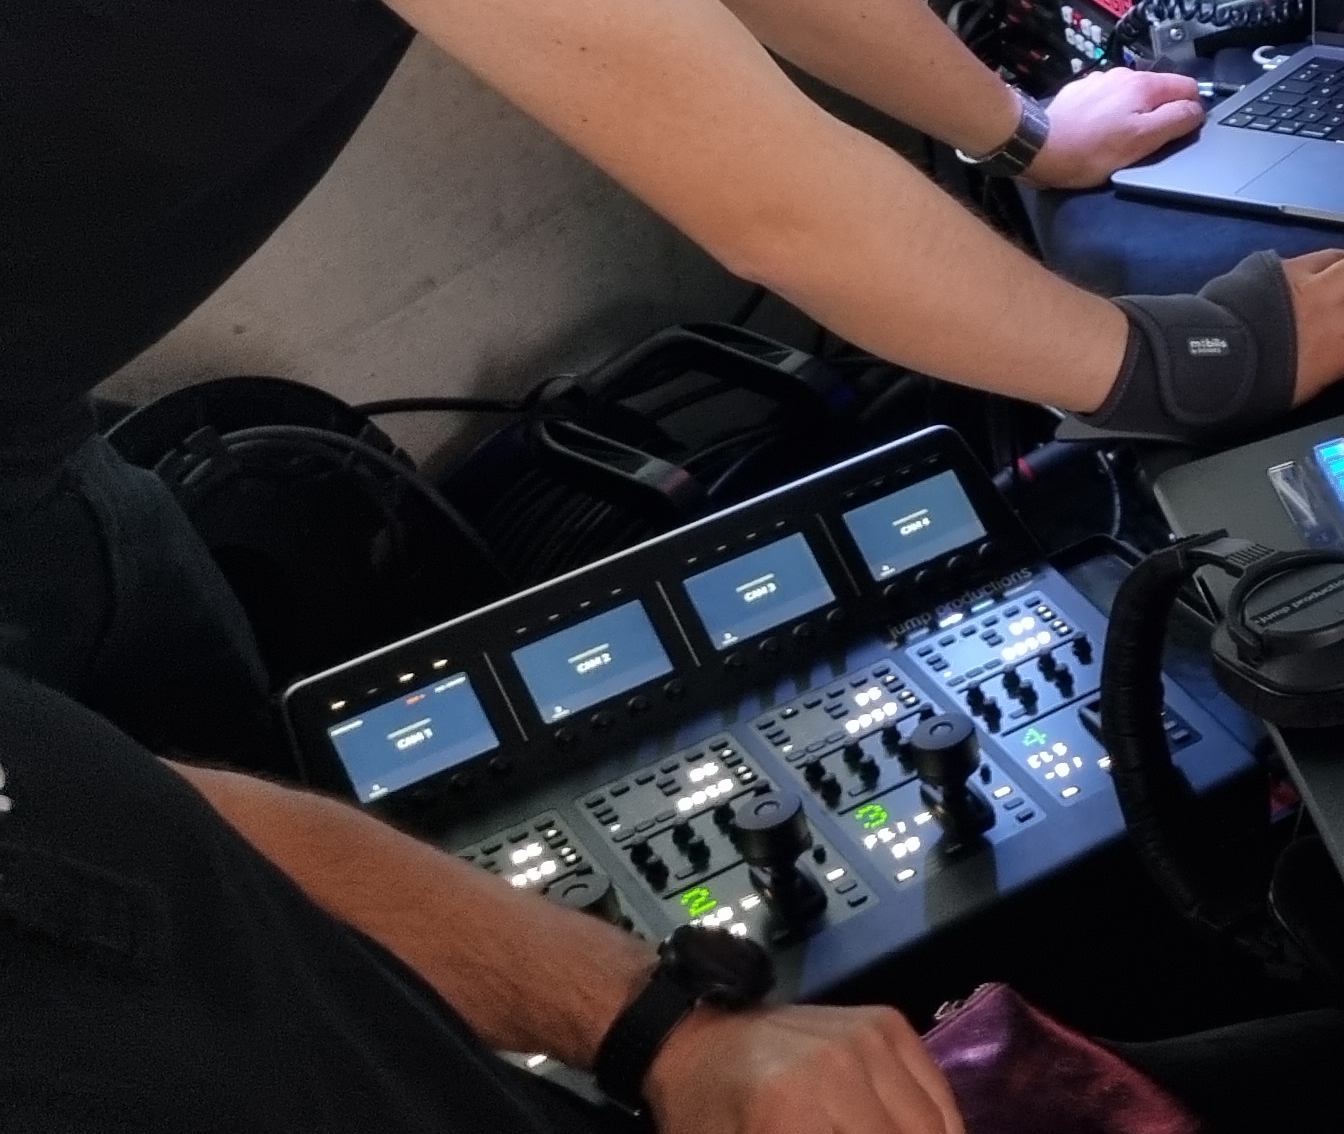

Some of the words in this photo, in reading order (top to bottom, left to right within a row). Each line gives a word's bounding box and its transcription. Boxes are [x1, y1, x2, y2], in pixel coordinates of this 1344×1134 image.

[744, 585, 768, 602] CAM
[889, 610, 931, 638] jump
[935, 567, 1033, 615] productions
[1260, 604, 1291, 624] jump
[577, 655, 602, 674] CAM
[396, 731, 424, 751] CAM
[1022, 727, 1048, 748] 4
